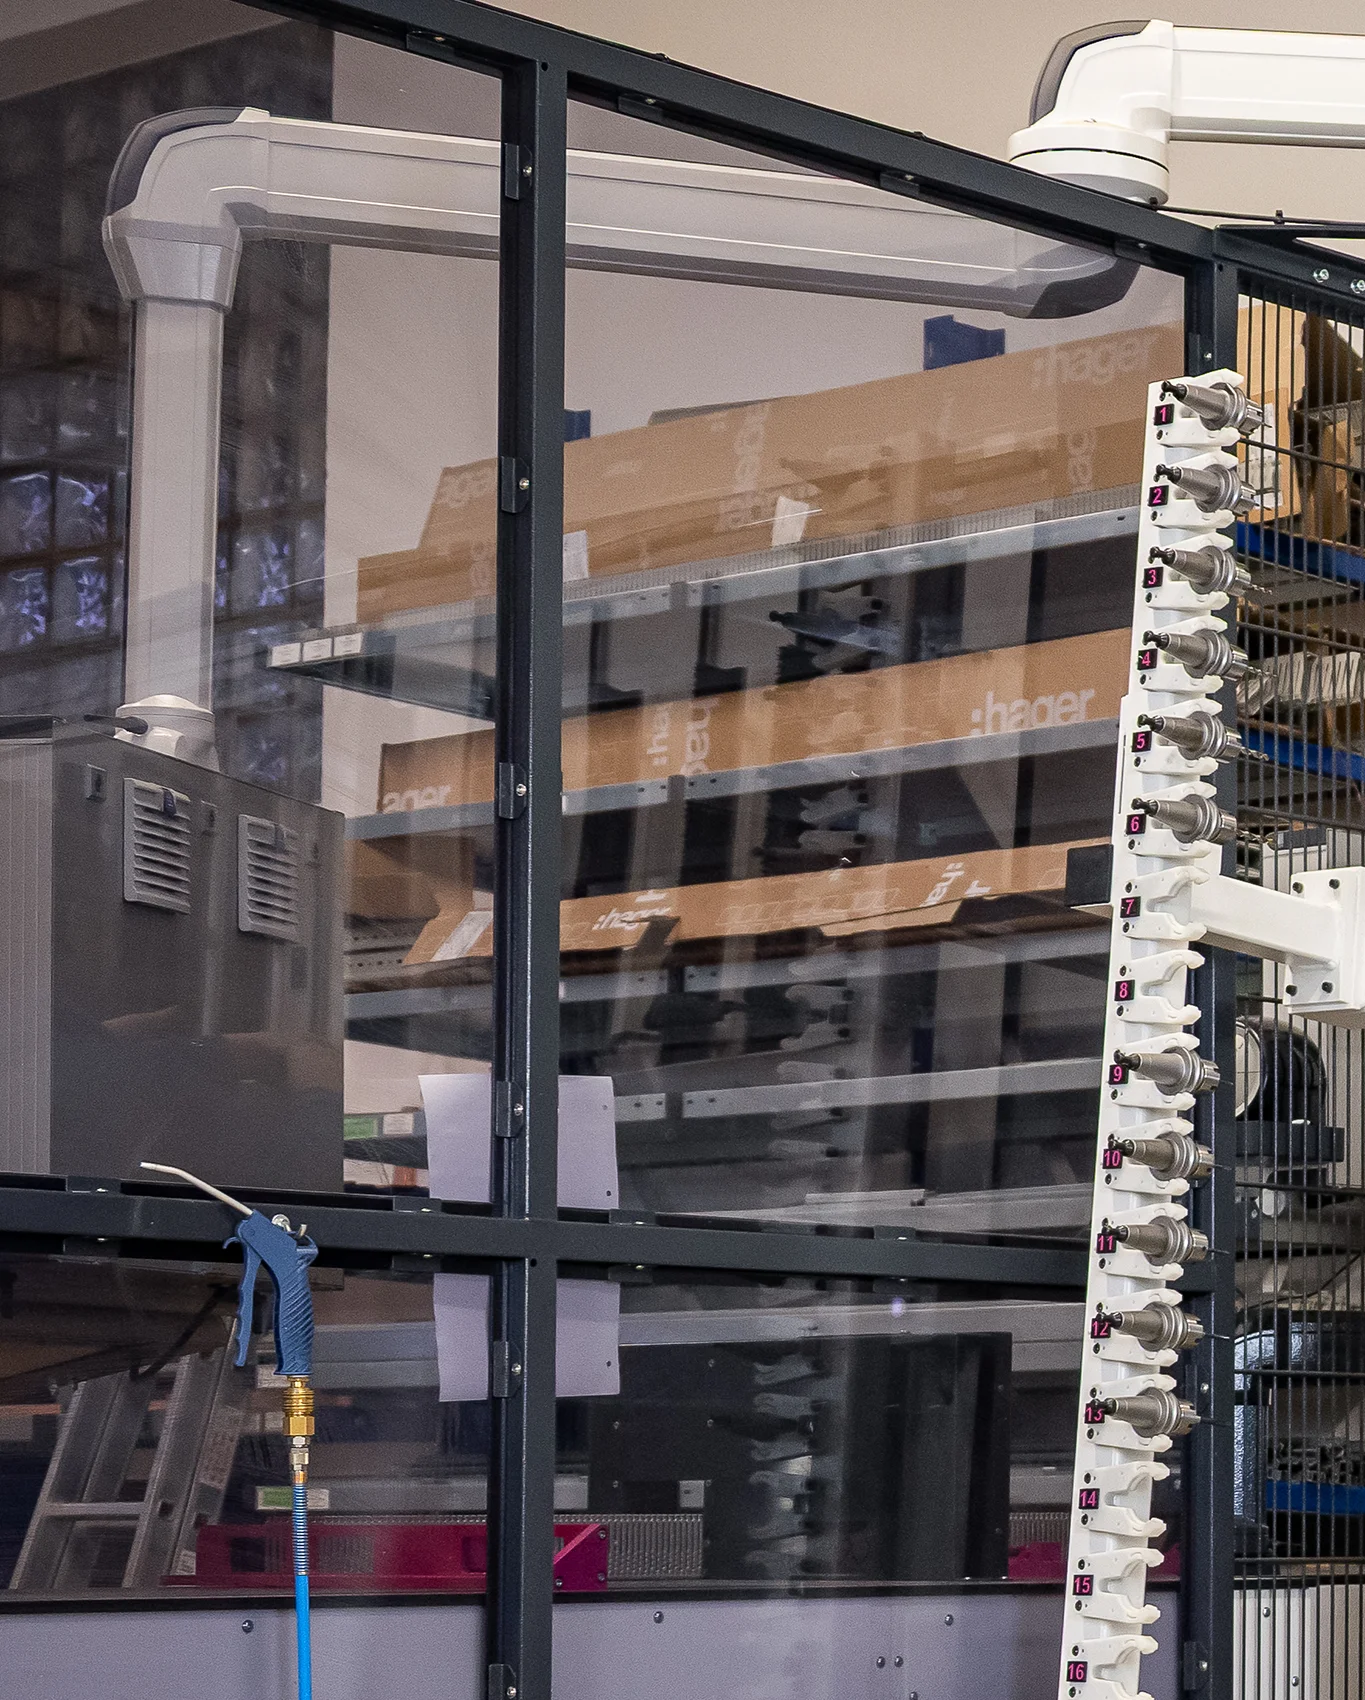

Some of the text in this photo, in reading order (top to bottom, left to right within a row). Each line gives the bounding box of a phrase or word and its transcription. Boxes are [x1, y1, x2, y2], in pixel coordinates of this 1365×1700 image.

[1160, 407, 1166, 422] 1
[1153, 488, 1162, 504] 2
[1148, 569, 1156, 584] 3
[1142, 652, 1150, 666] 4
[1137, 733, 1145, 749] 5
[1131, 816, 1139, 831] 6
[1126, 899, 1134, 914] 7
[1119, 982, 1128, 998] 8
[1114, 1066, 1122, 1082] 9
[1104, 1150, 1120, 1166] 10
[1098, 1236, 1113, 1250] 11
[1092, 1321, 1108, 1336] 12
[1081, 1491, 1096, 1506] 14
[1075, 1577, 1090, 1593] 15
[1069, 1664, 1084, 1680] 16
